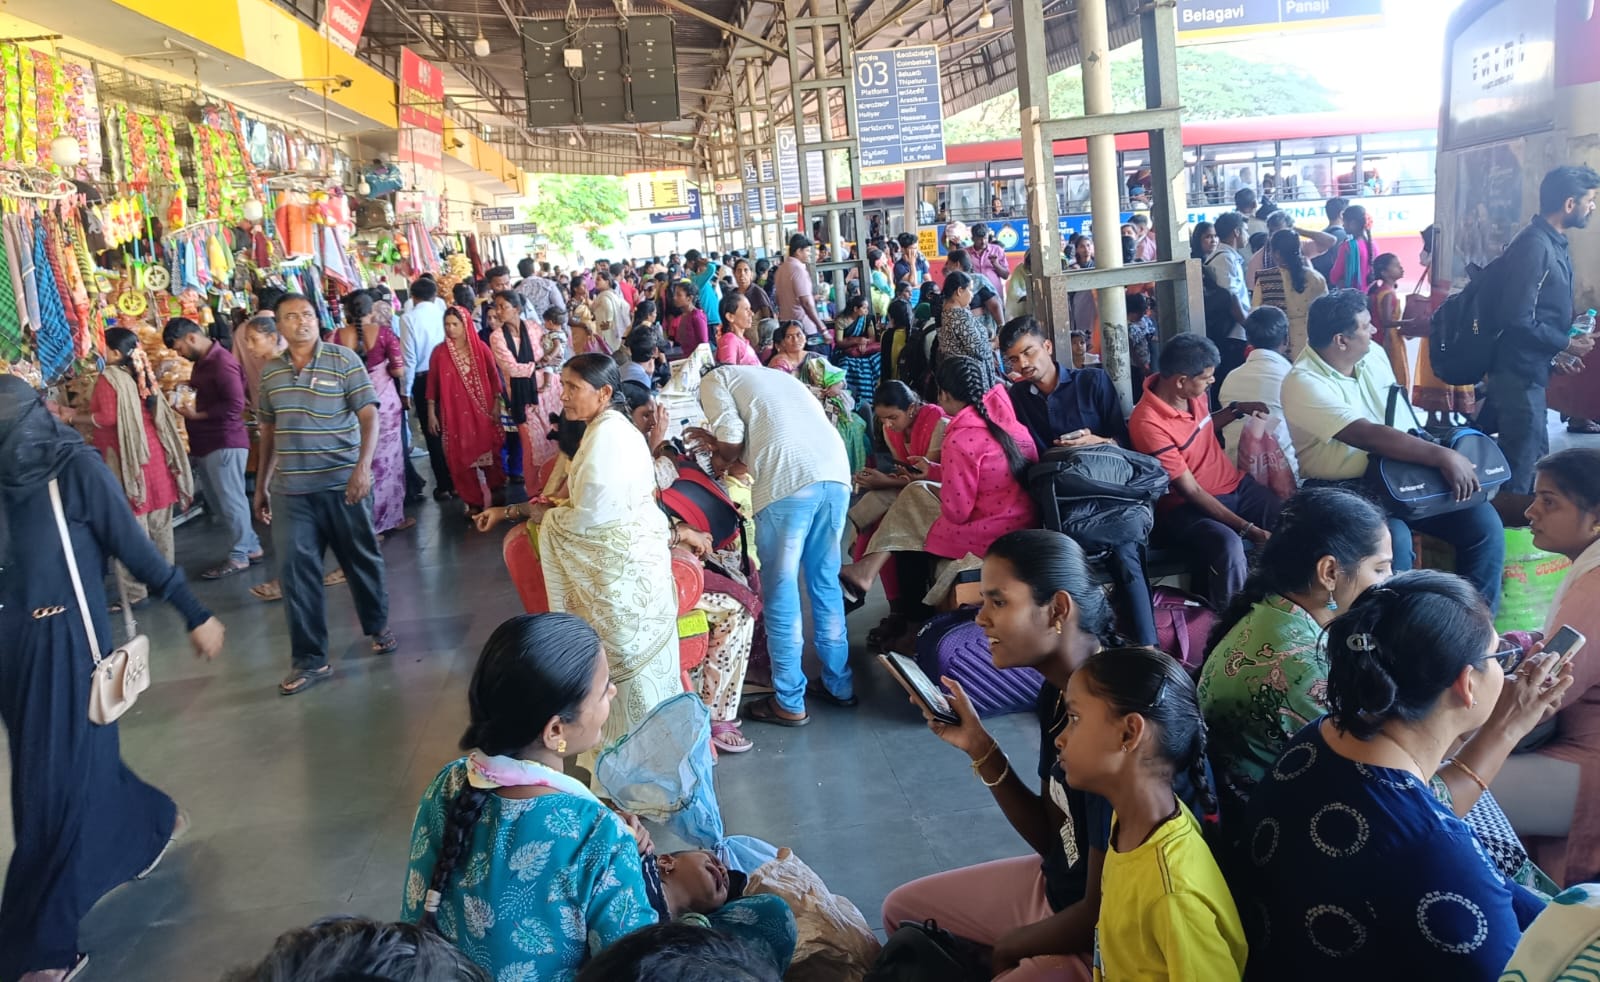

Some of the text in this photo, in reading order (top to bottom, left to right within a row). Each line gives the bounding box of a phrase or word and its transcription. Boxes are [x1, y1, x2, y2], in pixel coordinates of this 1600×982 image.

[1182, 5, 1245, 24] Belagavi
[1286, 0, 1330, 14] Panaji
[858, 61, 889, 87] 03
[861, 88, 889, 96] Platform
